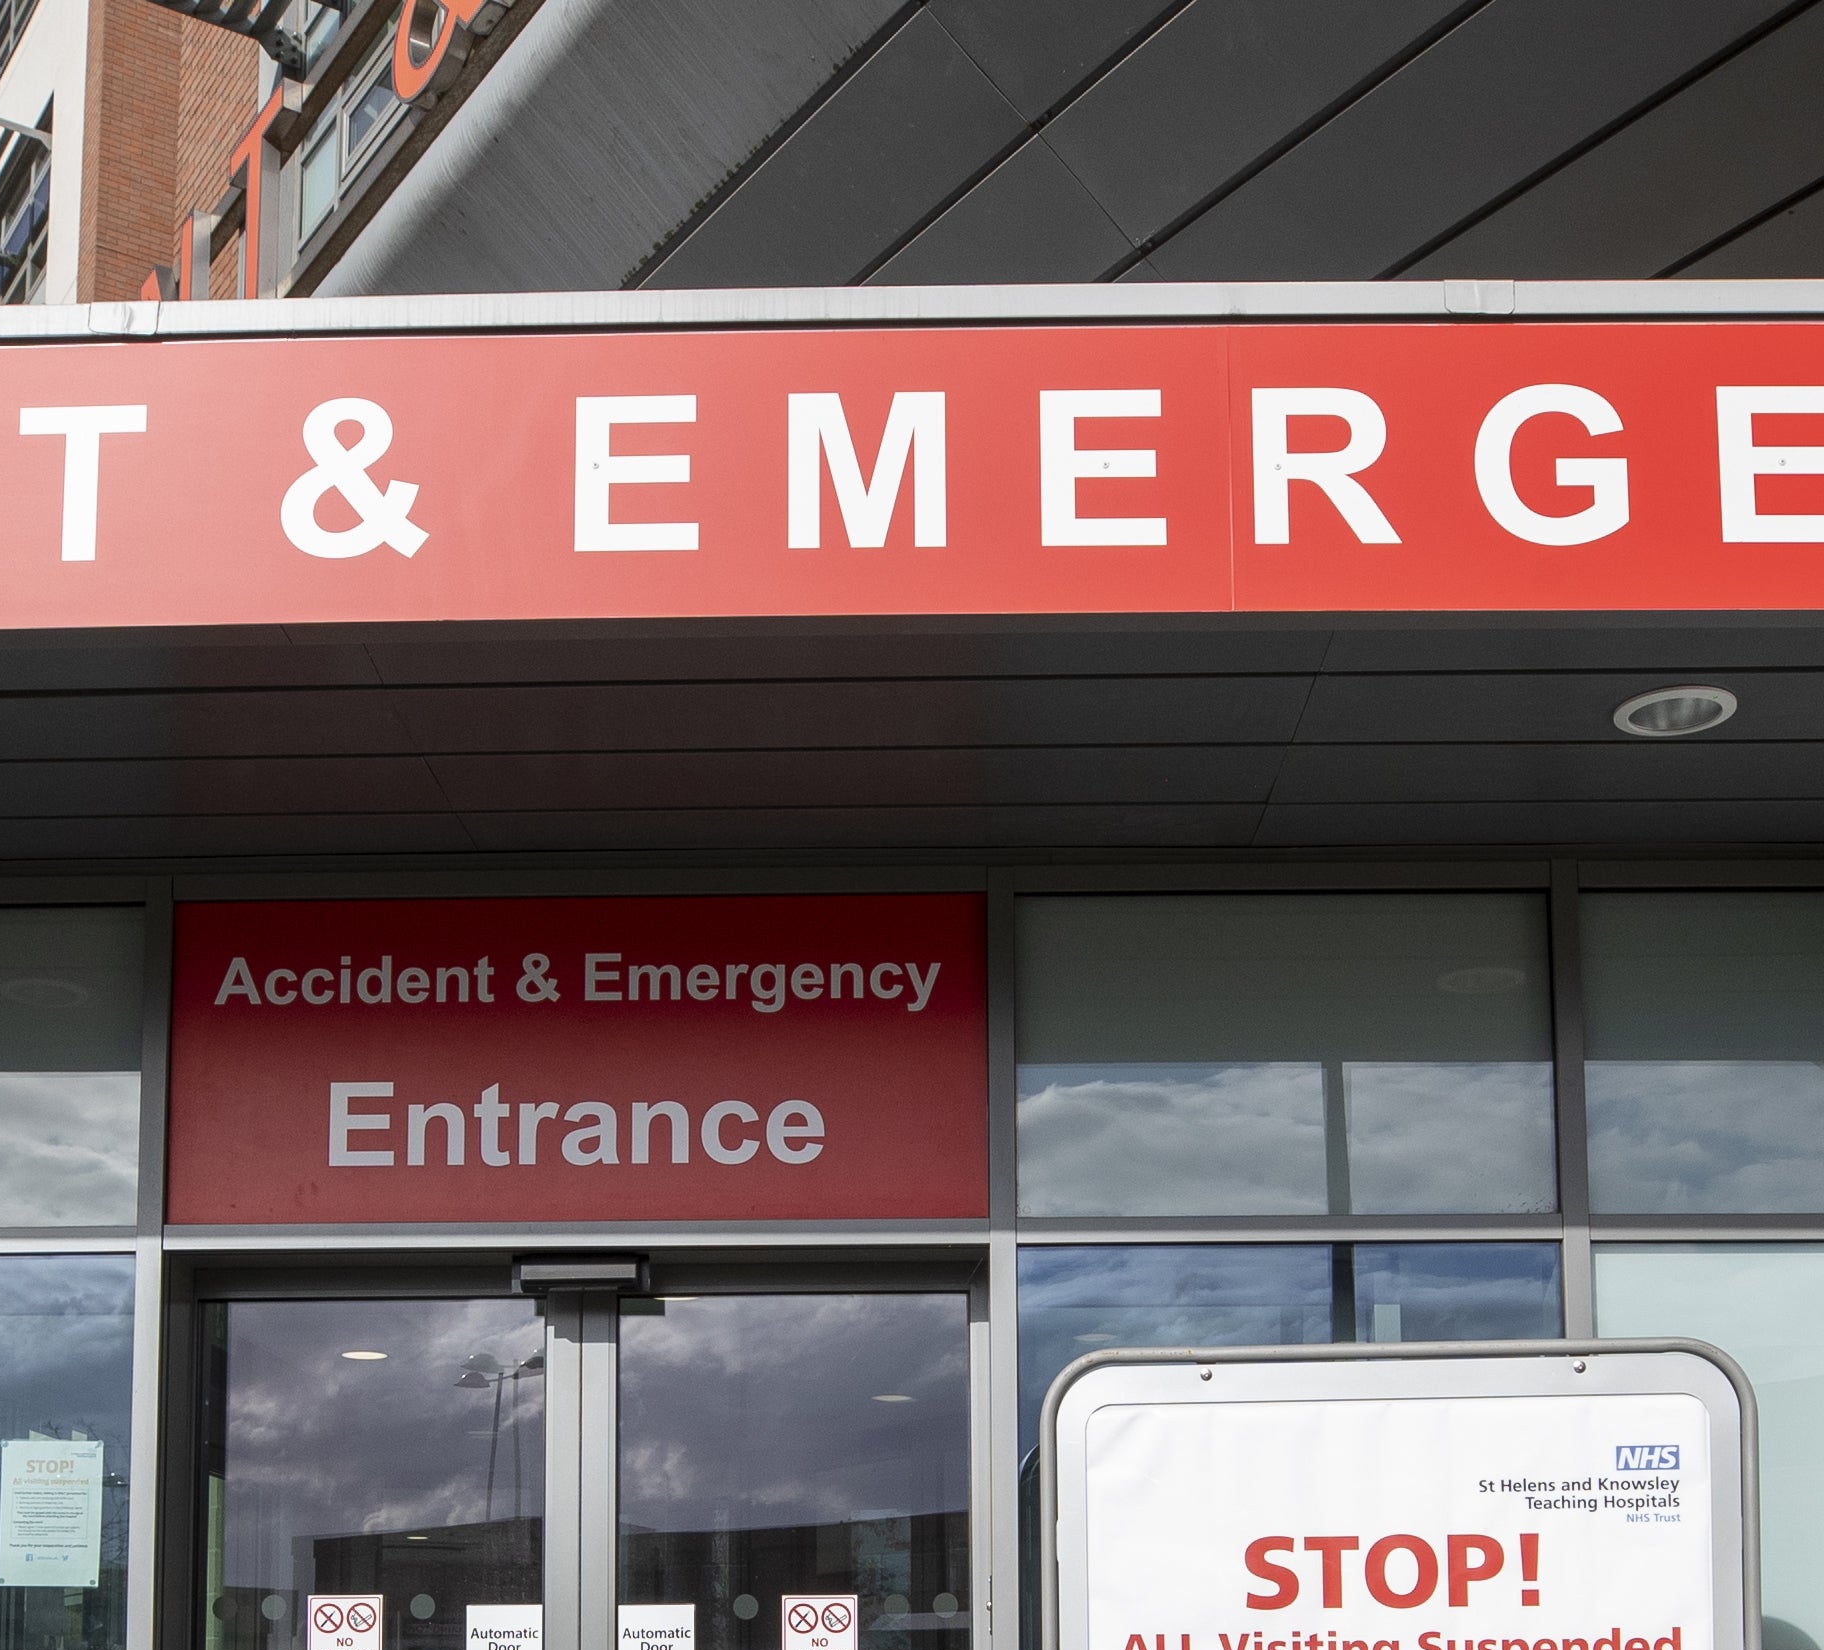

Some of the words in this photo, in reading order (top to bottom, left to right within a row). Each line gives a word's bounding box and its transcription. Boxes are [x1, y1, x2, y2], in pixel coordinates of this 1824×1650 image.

[281, 396, 430, 560] &
[214, 955, 494, 1006] Accident
[516, 953, 562, 1003] &
[583, 952, 942, 1013] Emergency
[328, 1081, 826, 1167] Entrance
[25, 1459, 75, 1474] STOP!
[1617, 1445, 1679, 1470] NHS
[1479, 1480, 1495, 1493] St
[1501, 1478, 1555, 1492] Helens
[1562, 1477, 1591, 1491] and
[1599, 1476, 1679, 1494] Knowsley
[1525, 1495, 1597, 1512] Teaching
[1604, 1492, 1679, 1512] Hospitals
[1627, 1513, 1650, 1522] NHS
[1654, 1512, 1680, 1522] Trust
[1245, 1532, 1539, 1611] STOP!
[336, 1637, 354, 1647] NO
[470, 1627, 539, 1640] Automatic
[622, 1626, 692, 1641] Automatic
[811, 1637, 829, 1647] NO
